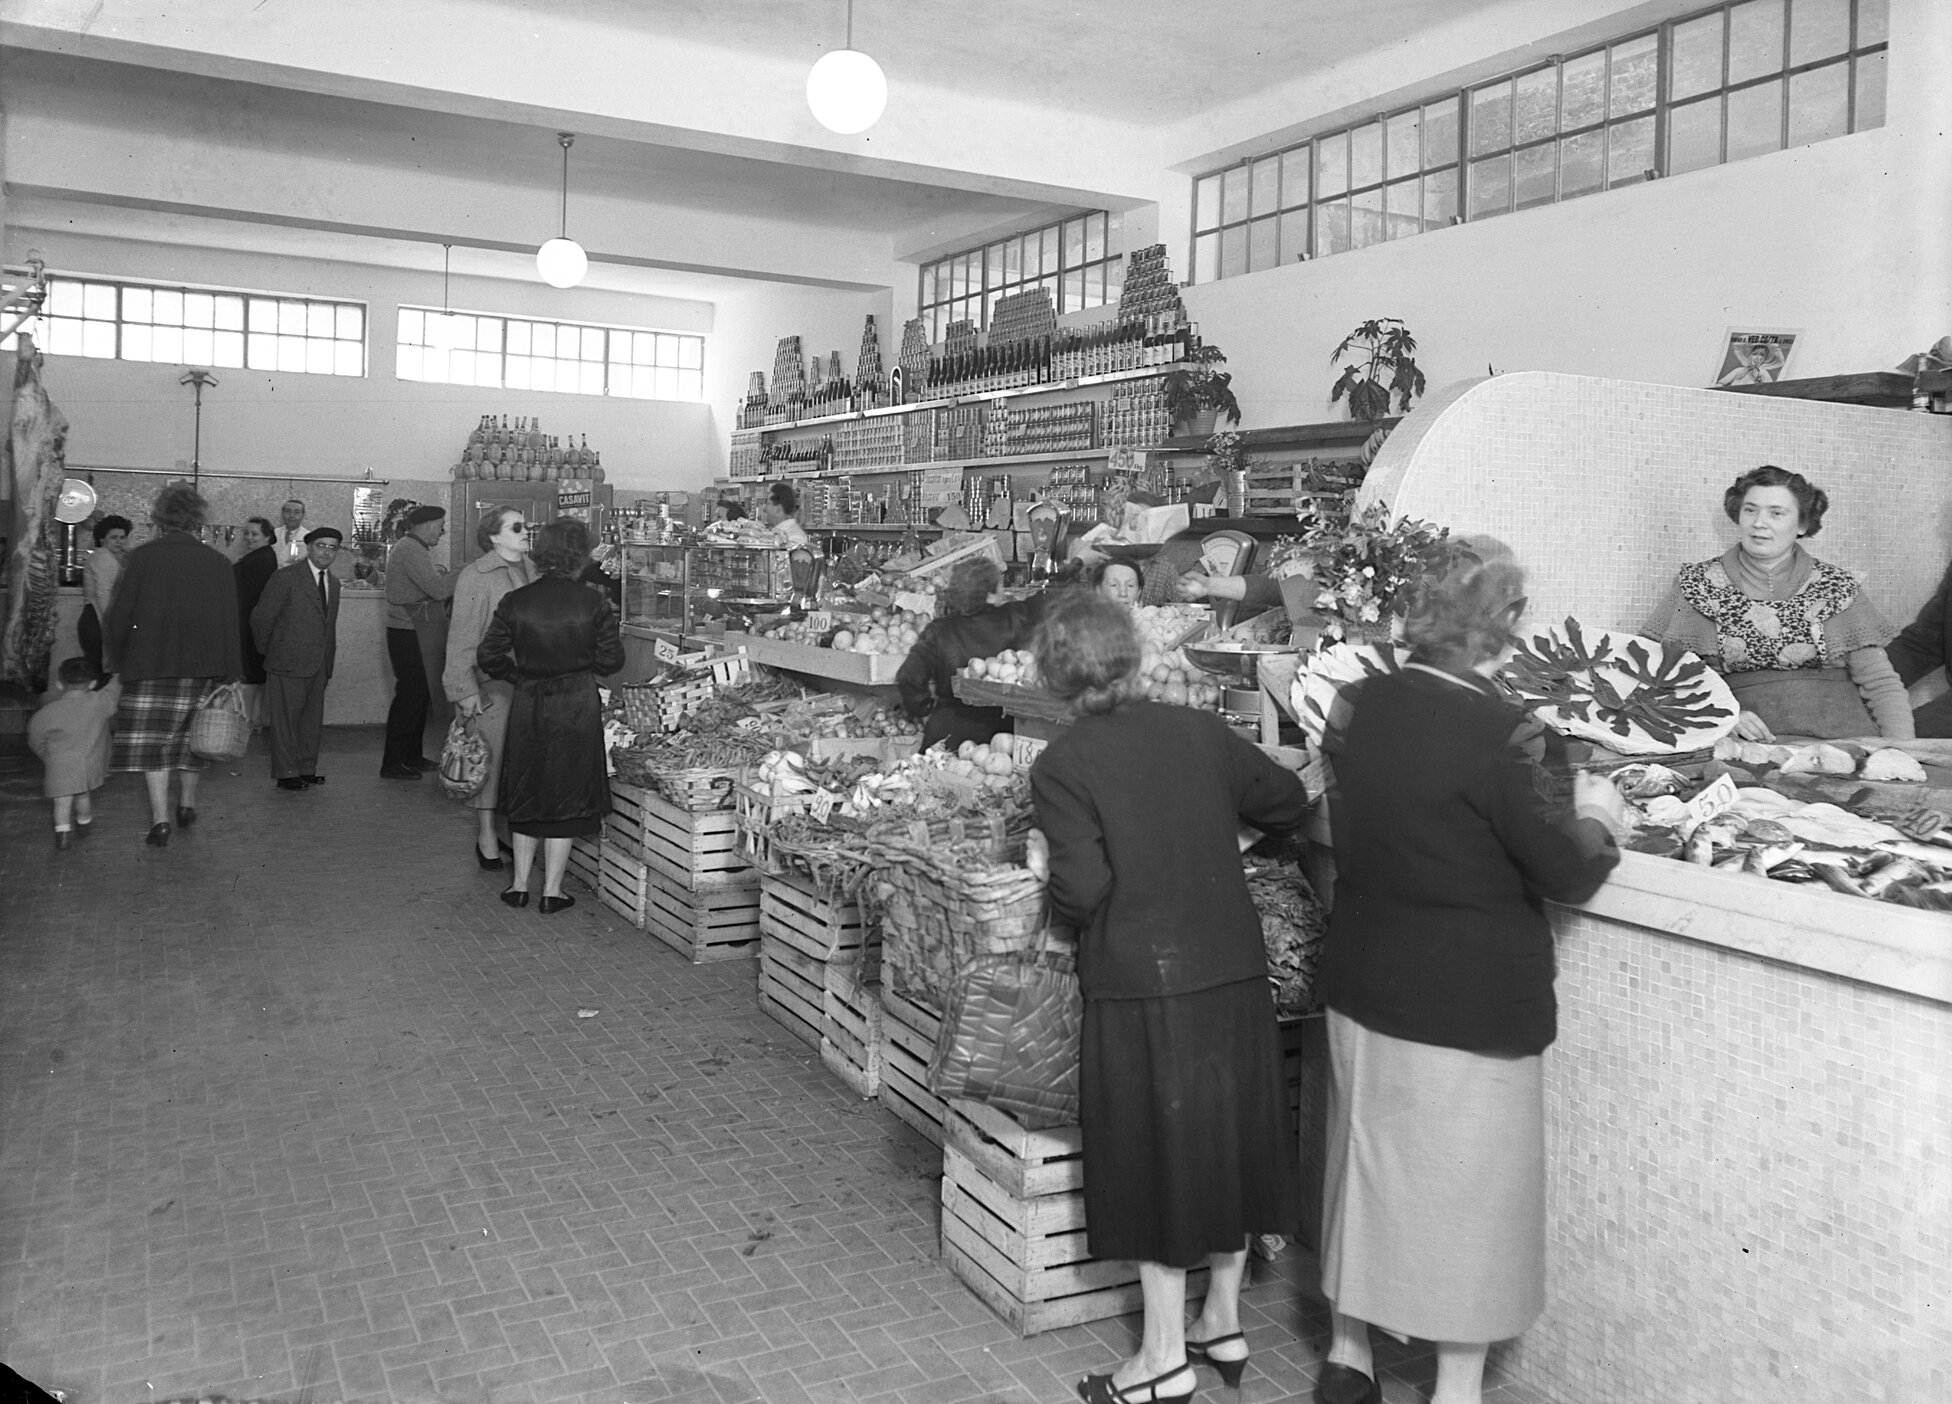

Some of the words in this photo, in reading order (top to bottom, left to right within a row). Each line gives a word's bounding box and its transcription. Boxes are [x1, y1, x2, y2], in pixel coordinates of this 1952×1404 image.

[1110, 451, 1135, 469] 450
[559, 494, 590, 505] CASAVIT
[809, 616, 827, 630] 100
[659, 645, 674, 660] 25
[1019, 741, 1042, 764] 18
[1699, 784, 1732, 817] 50
